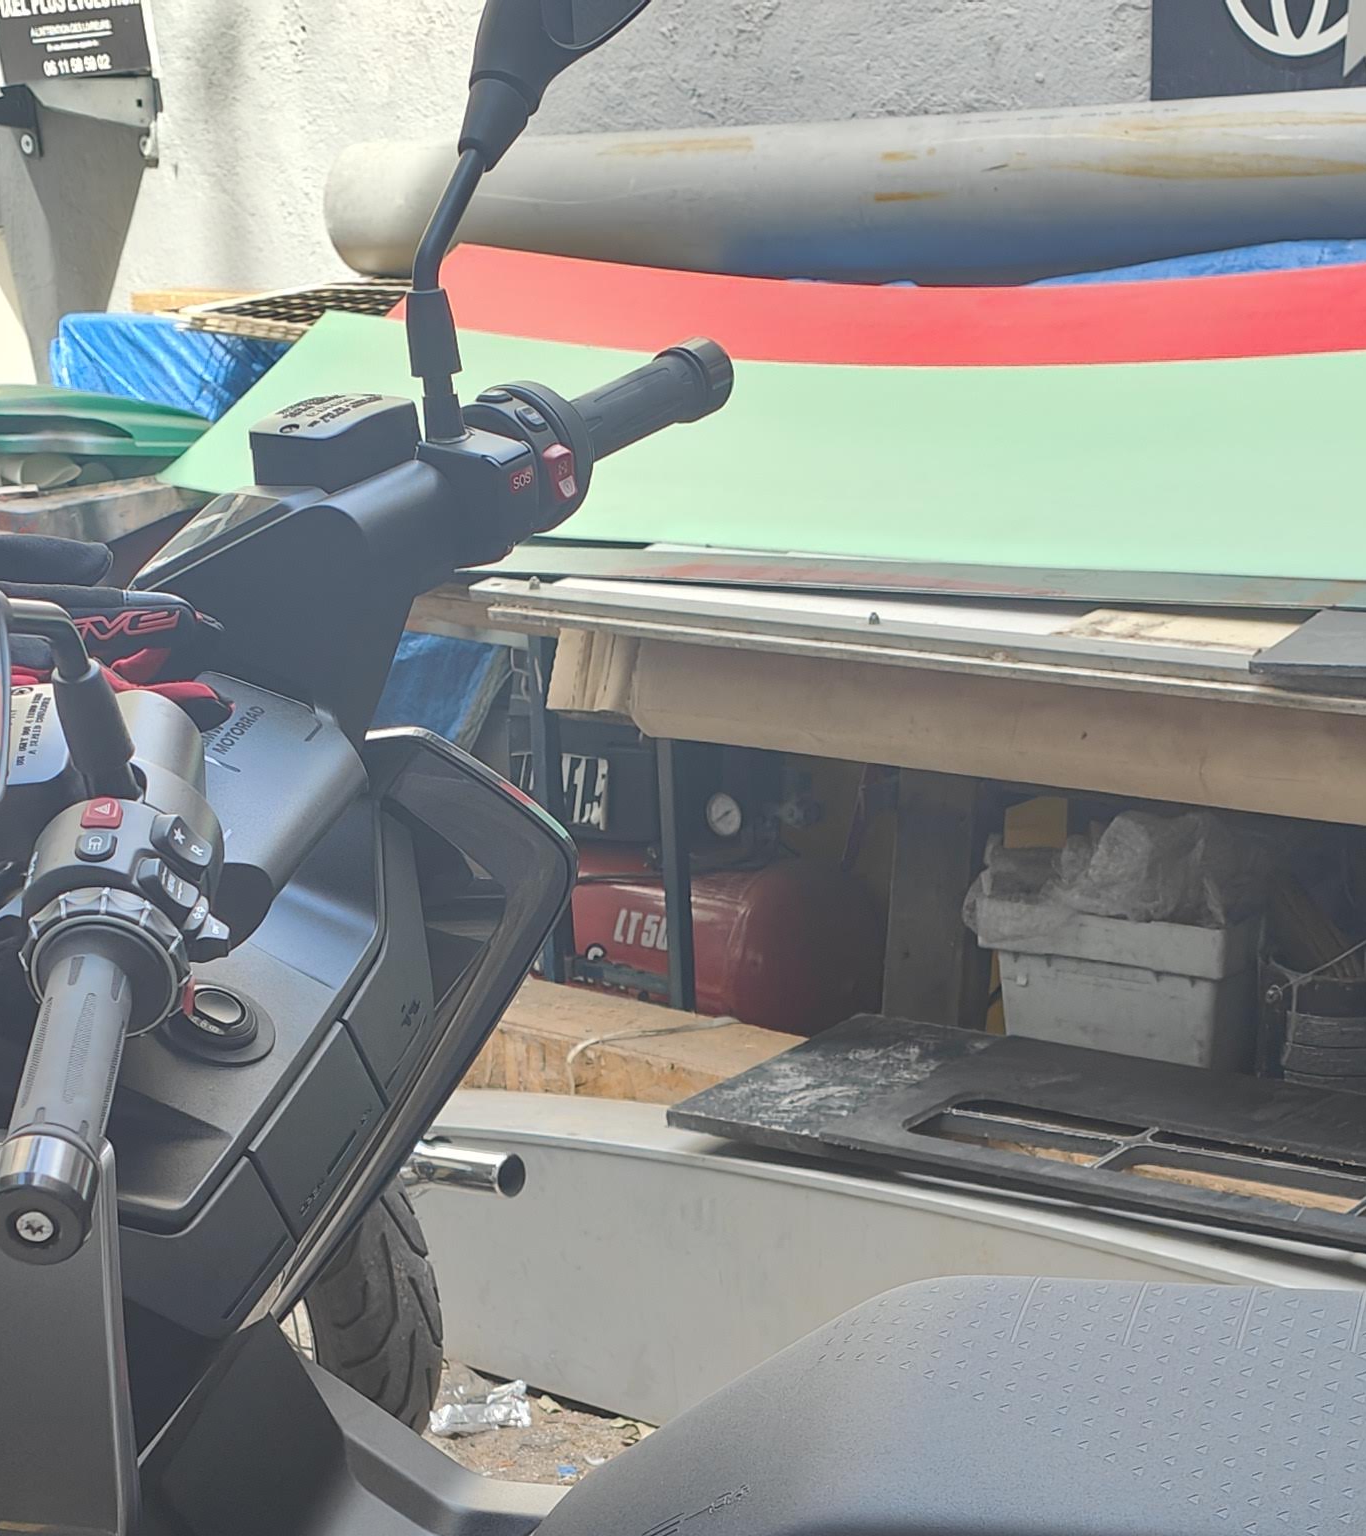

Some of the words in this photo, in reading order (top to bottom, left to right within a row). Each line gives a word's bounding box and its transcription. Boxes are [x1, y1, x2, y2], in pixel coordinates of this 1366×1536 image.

[43, 60, 59, 77] 06
[58, 58, 71, 75] 11
[512, 471, 532, 490] SOS
[212, 705, 266, 756] MOTORRAD
[190, 844, 204, 857] R
